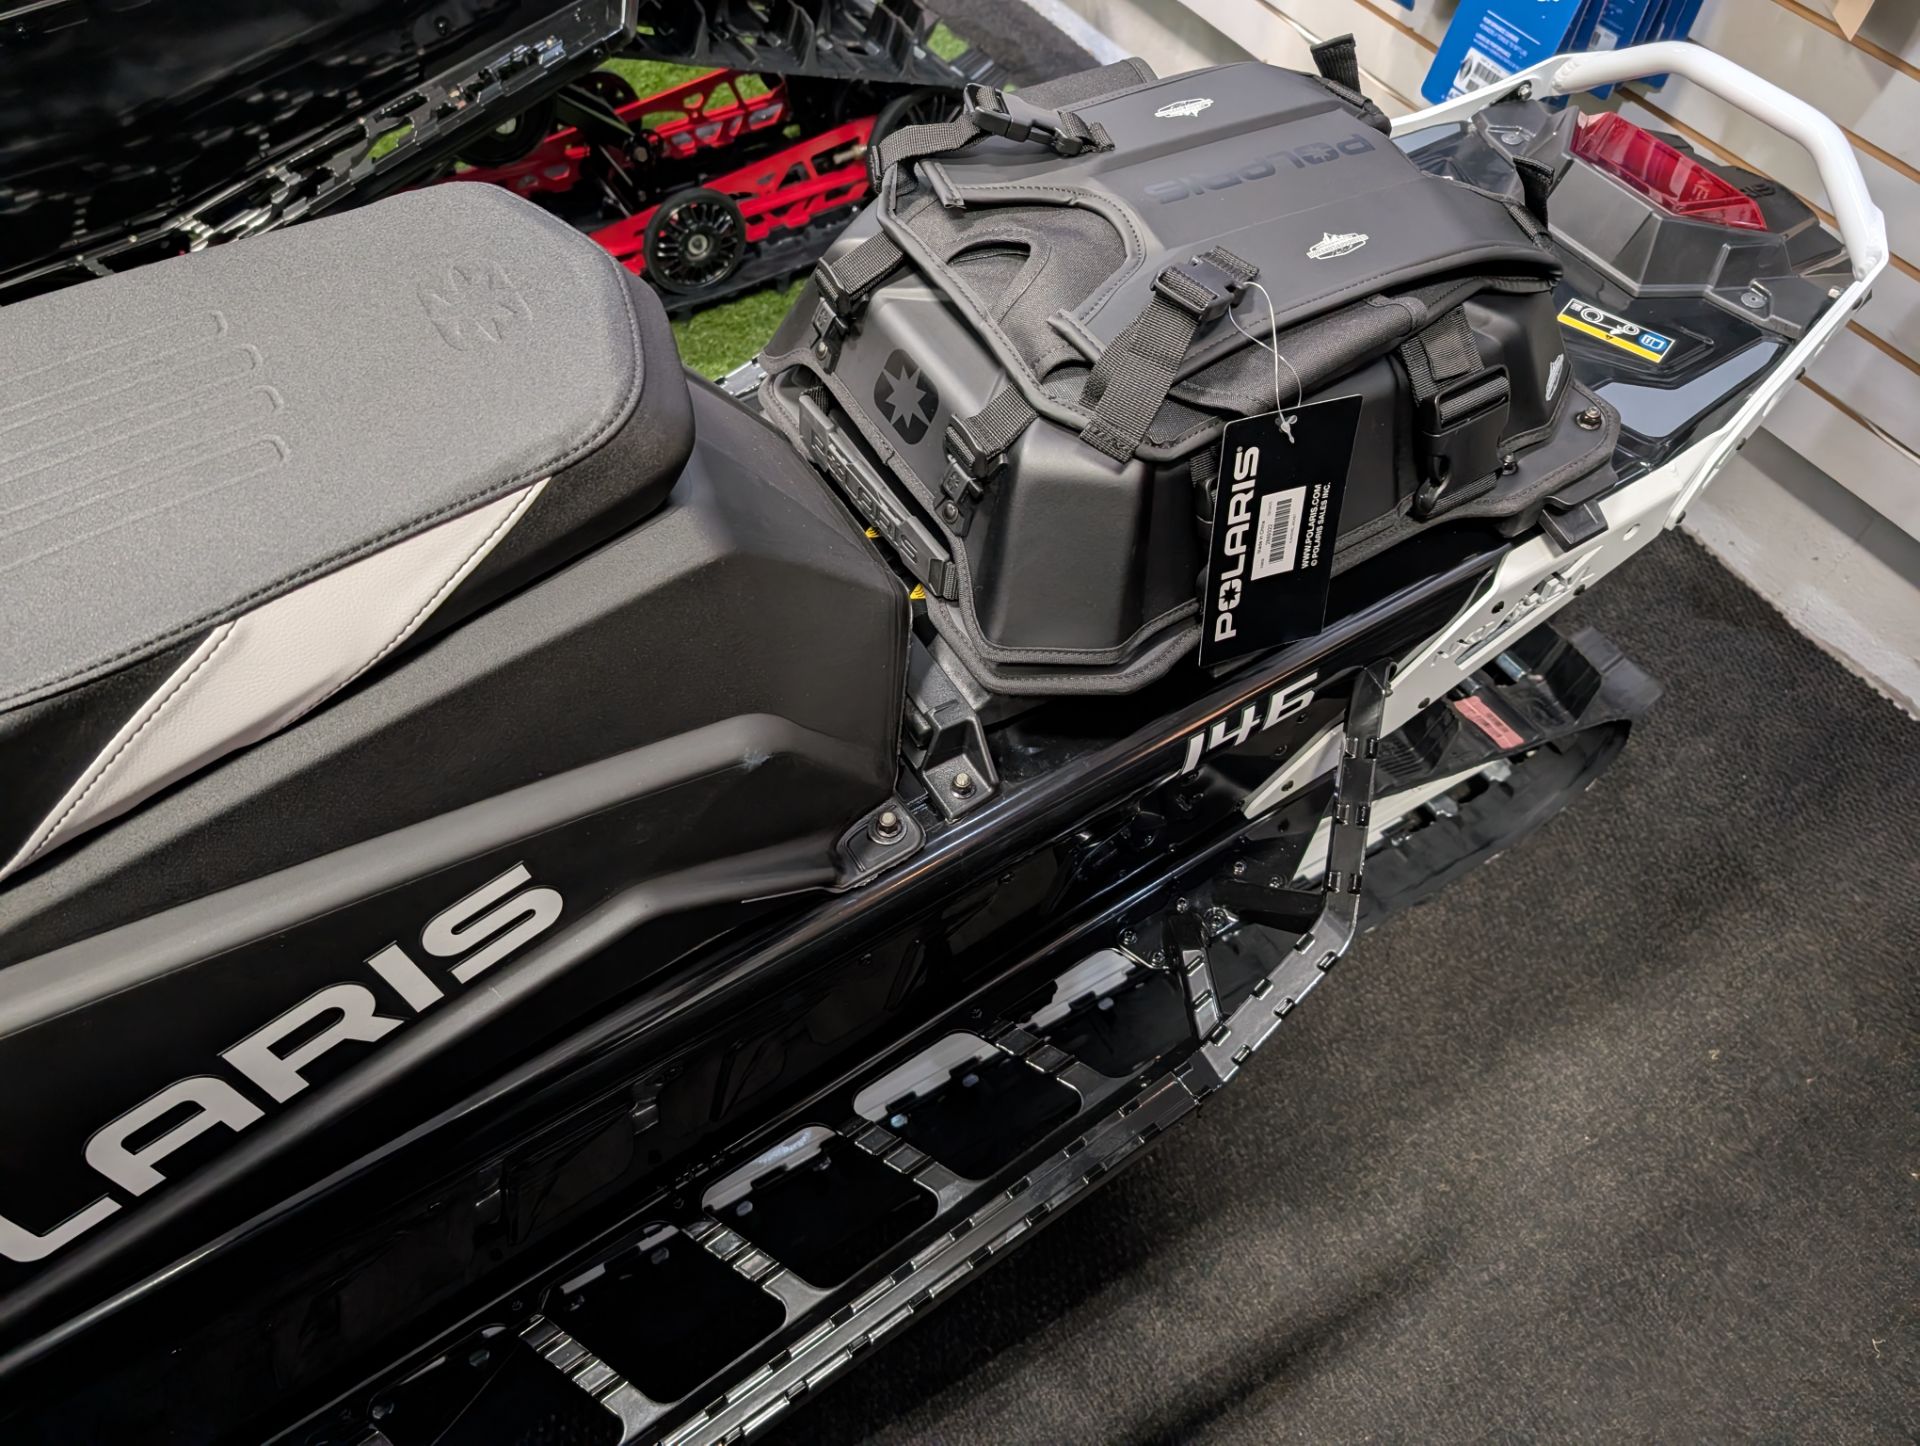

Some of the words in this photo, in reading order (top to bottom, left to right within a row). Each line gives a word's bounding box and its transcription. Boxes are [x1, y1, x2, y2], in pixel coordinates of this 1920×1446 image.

[1214, 446, 1260, 642] POLARIS
[1301, 484, 1322, 570] WWW.POLARIS.COM
[1312, 525, 1324, 559] POLARIS
[1318, 499, 1328, 525] SALES
[1180, 671, 1319, 775] 146
